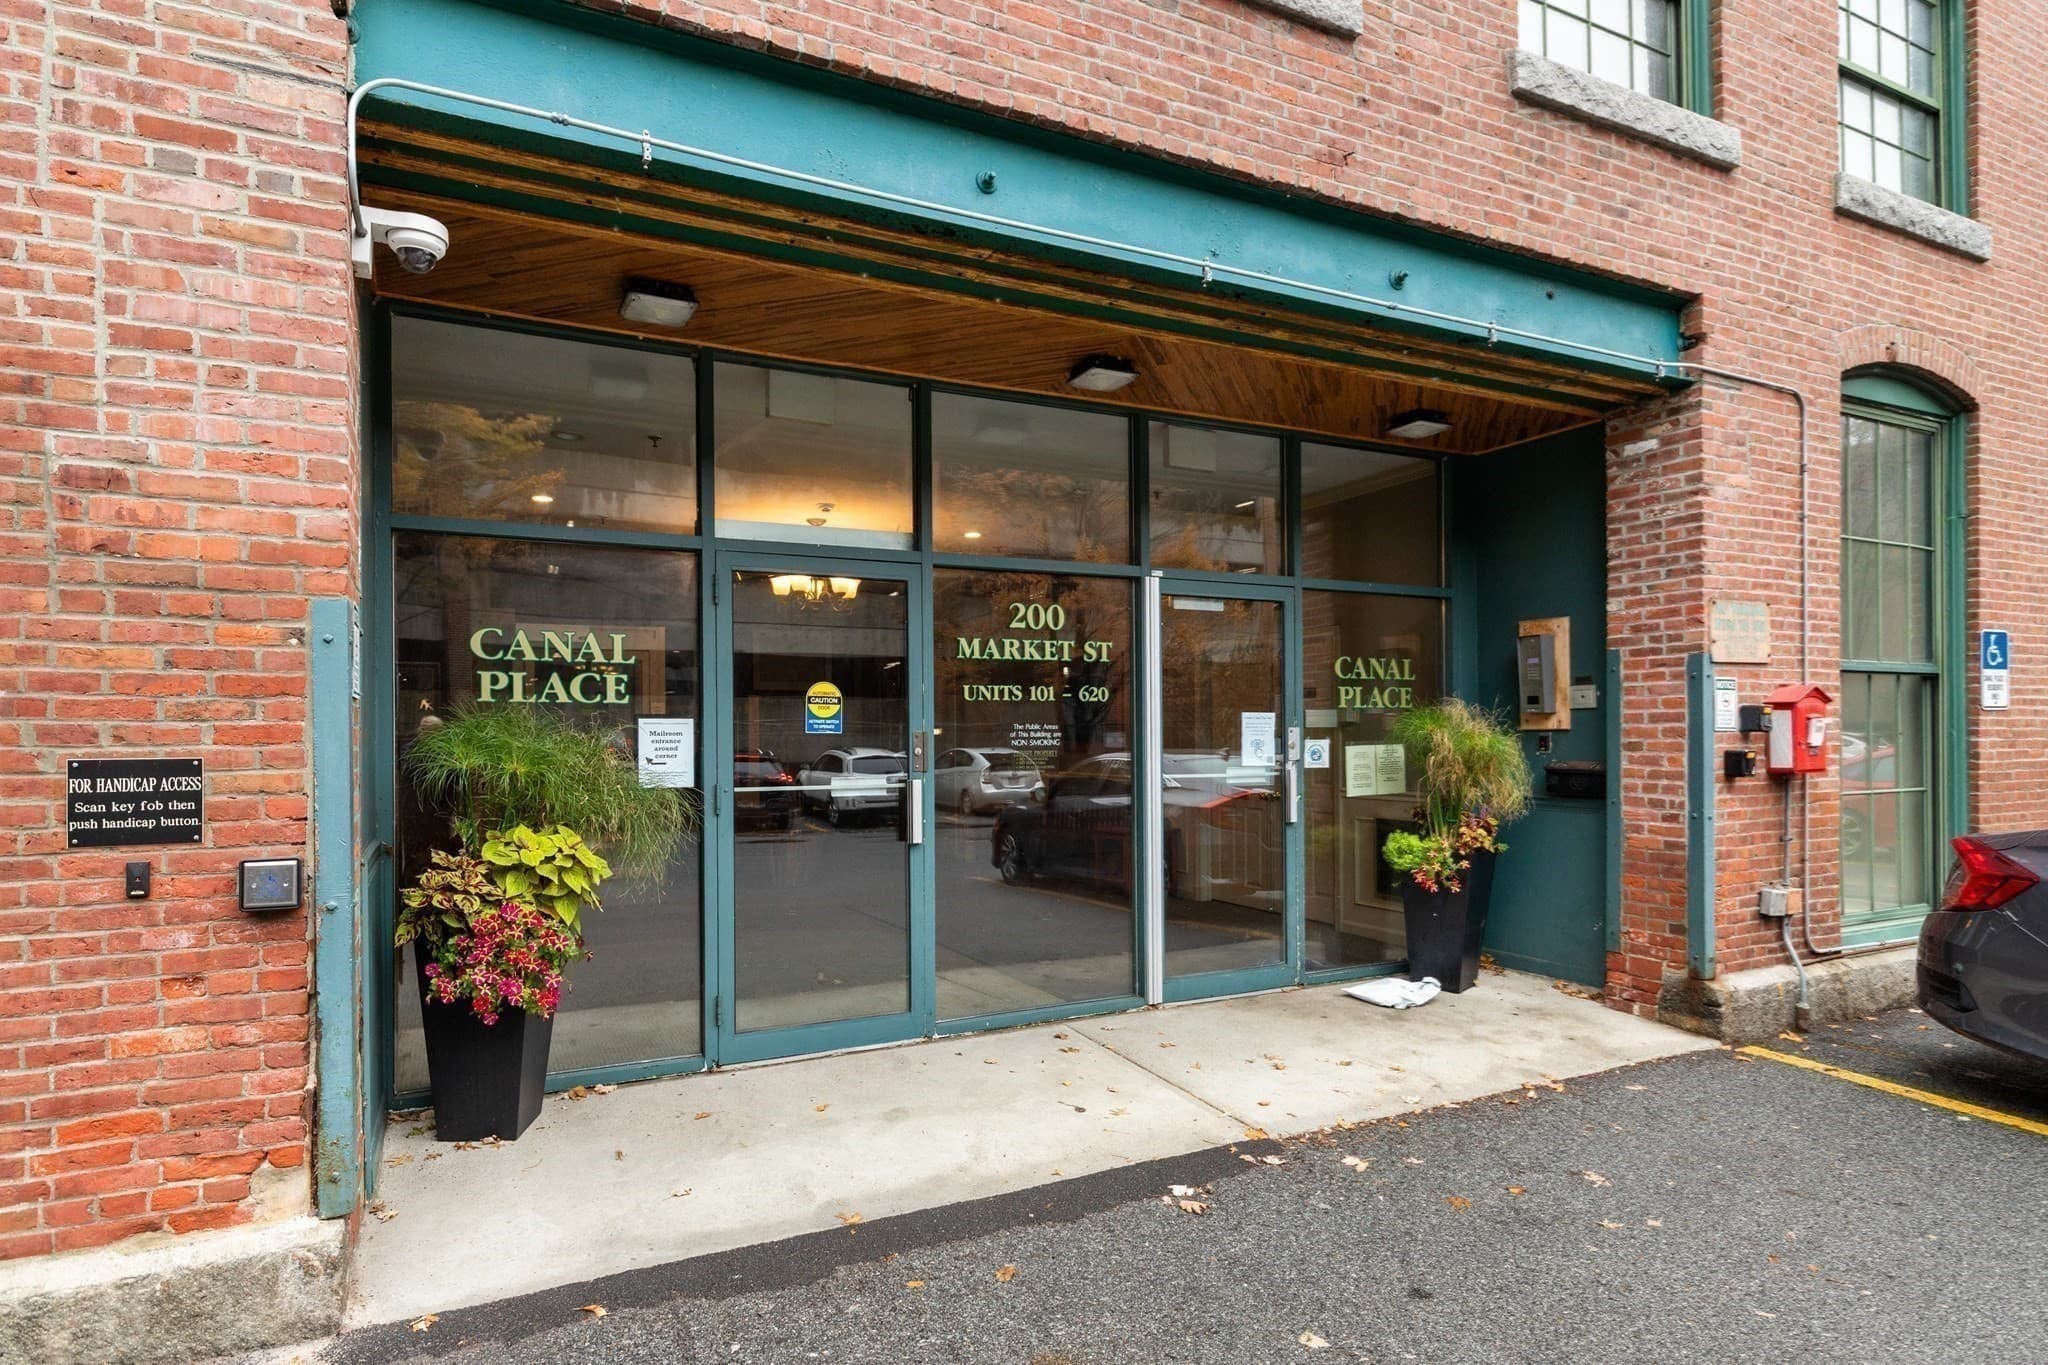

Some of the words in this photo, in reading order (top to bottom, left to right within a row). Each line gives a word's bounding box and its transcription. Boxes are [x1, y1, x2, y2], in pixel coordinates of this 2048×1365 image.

[1008, 602, 1064, 630] 200
[470, 627, 636, 664] CANAL
[956, 637, 1074, 661] MARKET
[1083, 640, 1112, 663] ST
[1334, 656, 1416, 681] CANAL
[476, 670, 631, 704] PLACE
[963, 684, 1022, 702] UNITS
[1029, 686, 1055, 702] 101
[1078, 686, 1109, 702] 620
[1338, 686, 1414, 709] PLACE
[69, 778, 93, 794] FOR
[97, 777, 157, 793] HANDICAP
[160, 776, 202, 792] ACCESS
[74, 802, 106, 813] Scan
[112, 801, 135, 813] key
[140, 801, 164, 811] fob
[168, 800, 196, 810] then
[69, 819, 98, 831] push
[102, 817, 156, 830] handicap
[161, 816, 201, 827] button.
